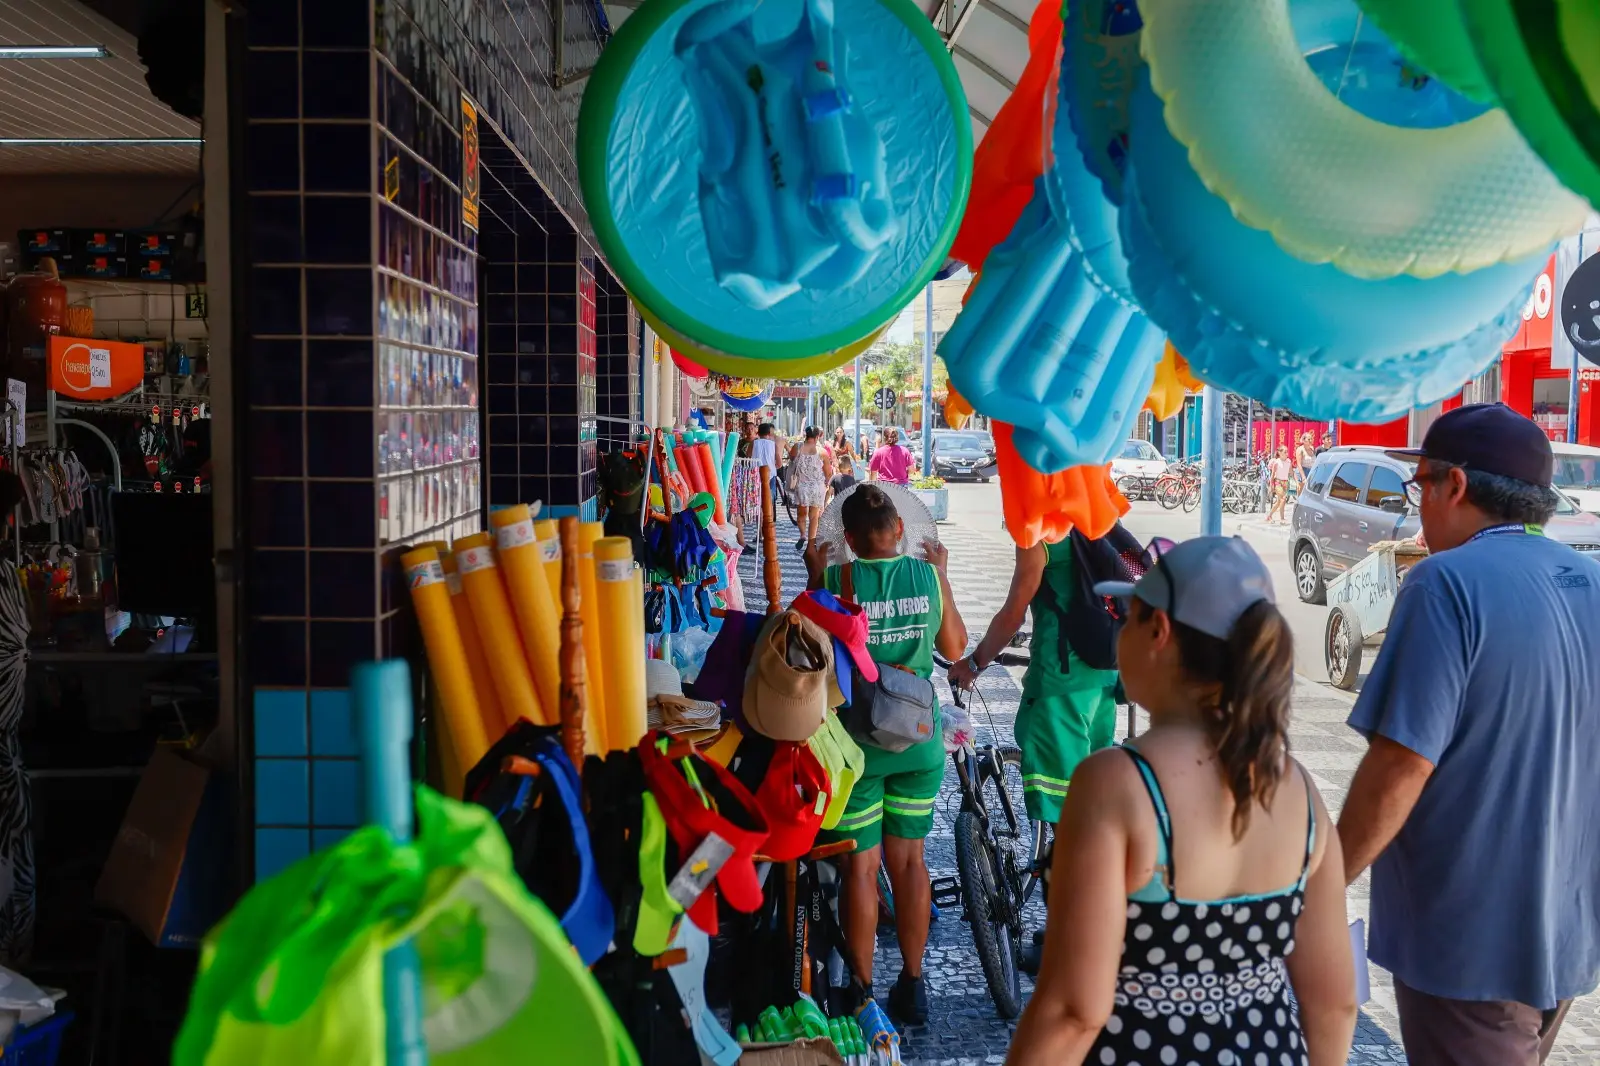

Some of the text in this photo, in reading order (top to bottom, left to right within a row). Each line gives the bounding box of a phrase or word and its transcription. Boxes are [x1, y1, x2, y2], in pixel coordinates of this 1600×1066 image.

[896, 596, 929, 616] VERDES
[882, 630, 923, 643] 3472-5091
[794, 906, 805, 989] GIORGIO ARMANI
